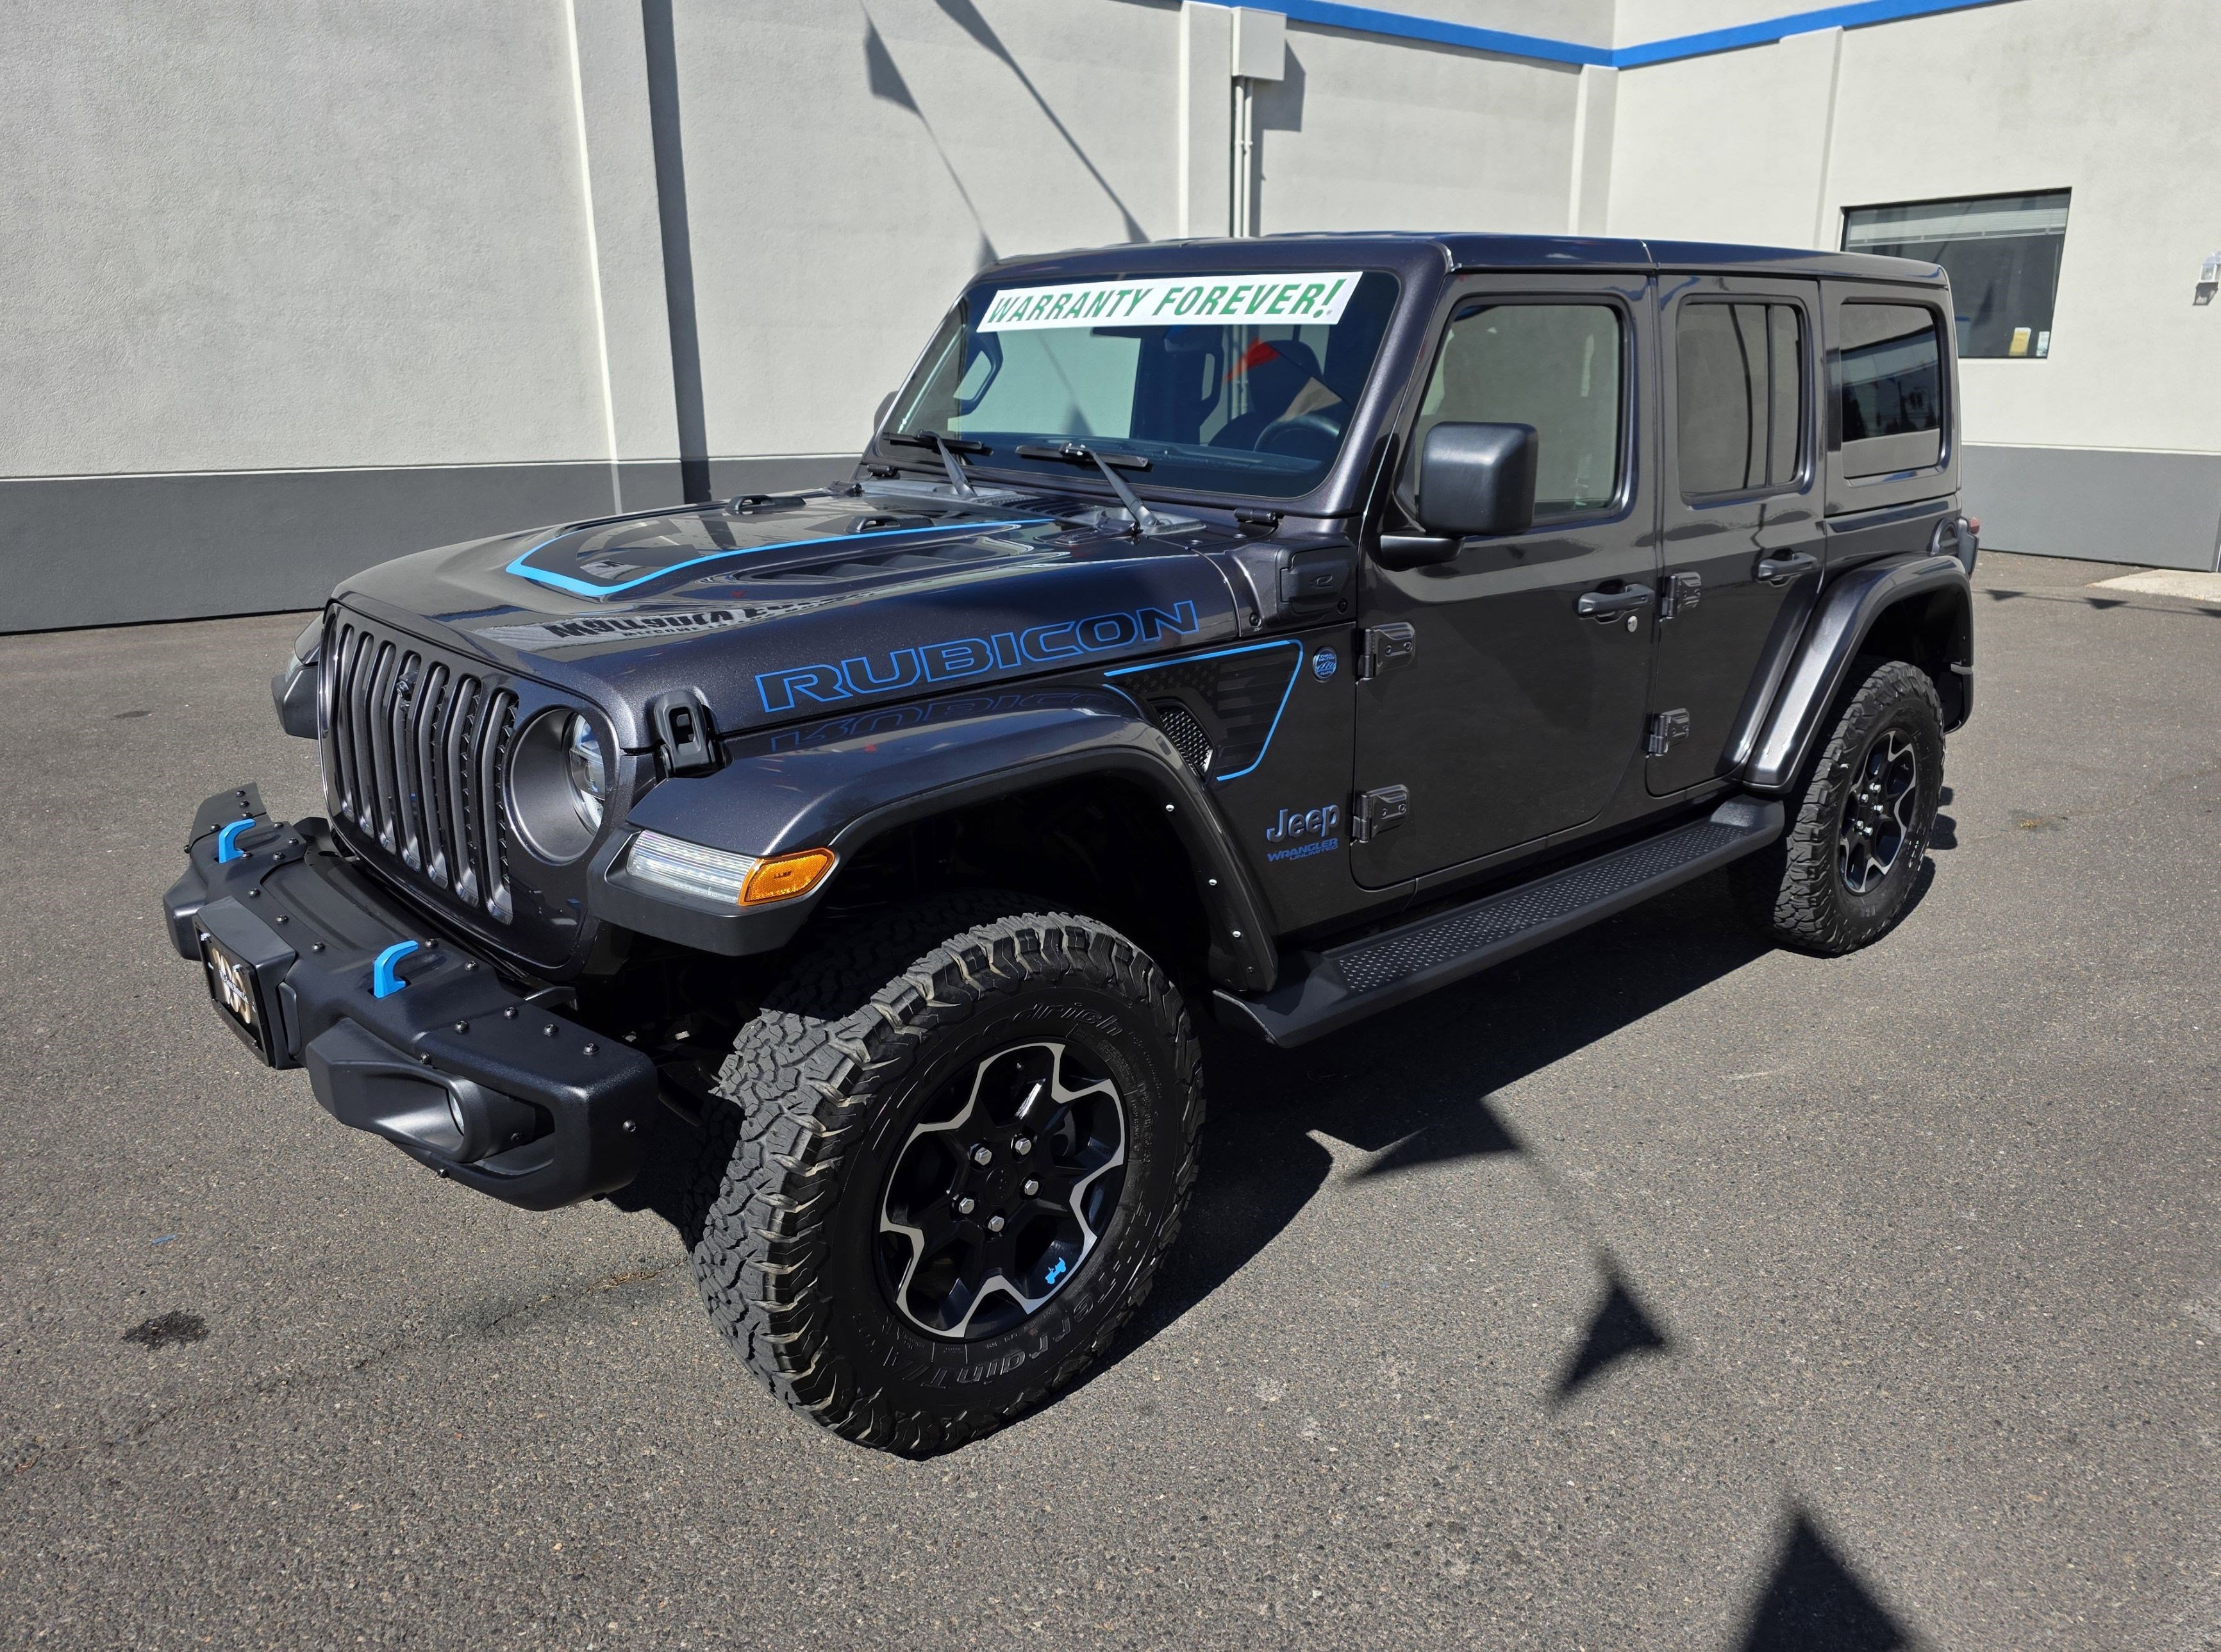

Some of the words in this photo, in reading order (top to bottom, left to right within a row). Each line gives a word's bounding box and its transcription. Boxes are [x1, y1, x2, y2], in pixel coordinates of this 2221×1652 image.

[987, 288, 1153, 324] WARRANTY
[1152, 278, 1347, 319] FOREVER!
[754, 599, 1199, 713] RUBICON
[1267, 805, 1340, 843] Jeep
[1267, 838, 1338, 862] WRANGLER
[1290, 845, 1338, 861] UNLIMITED
